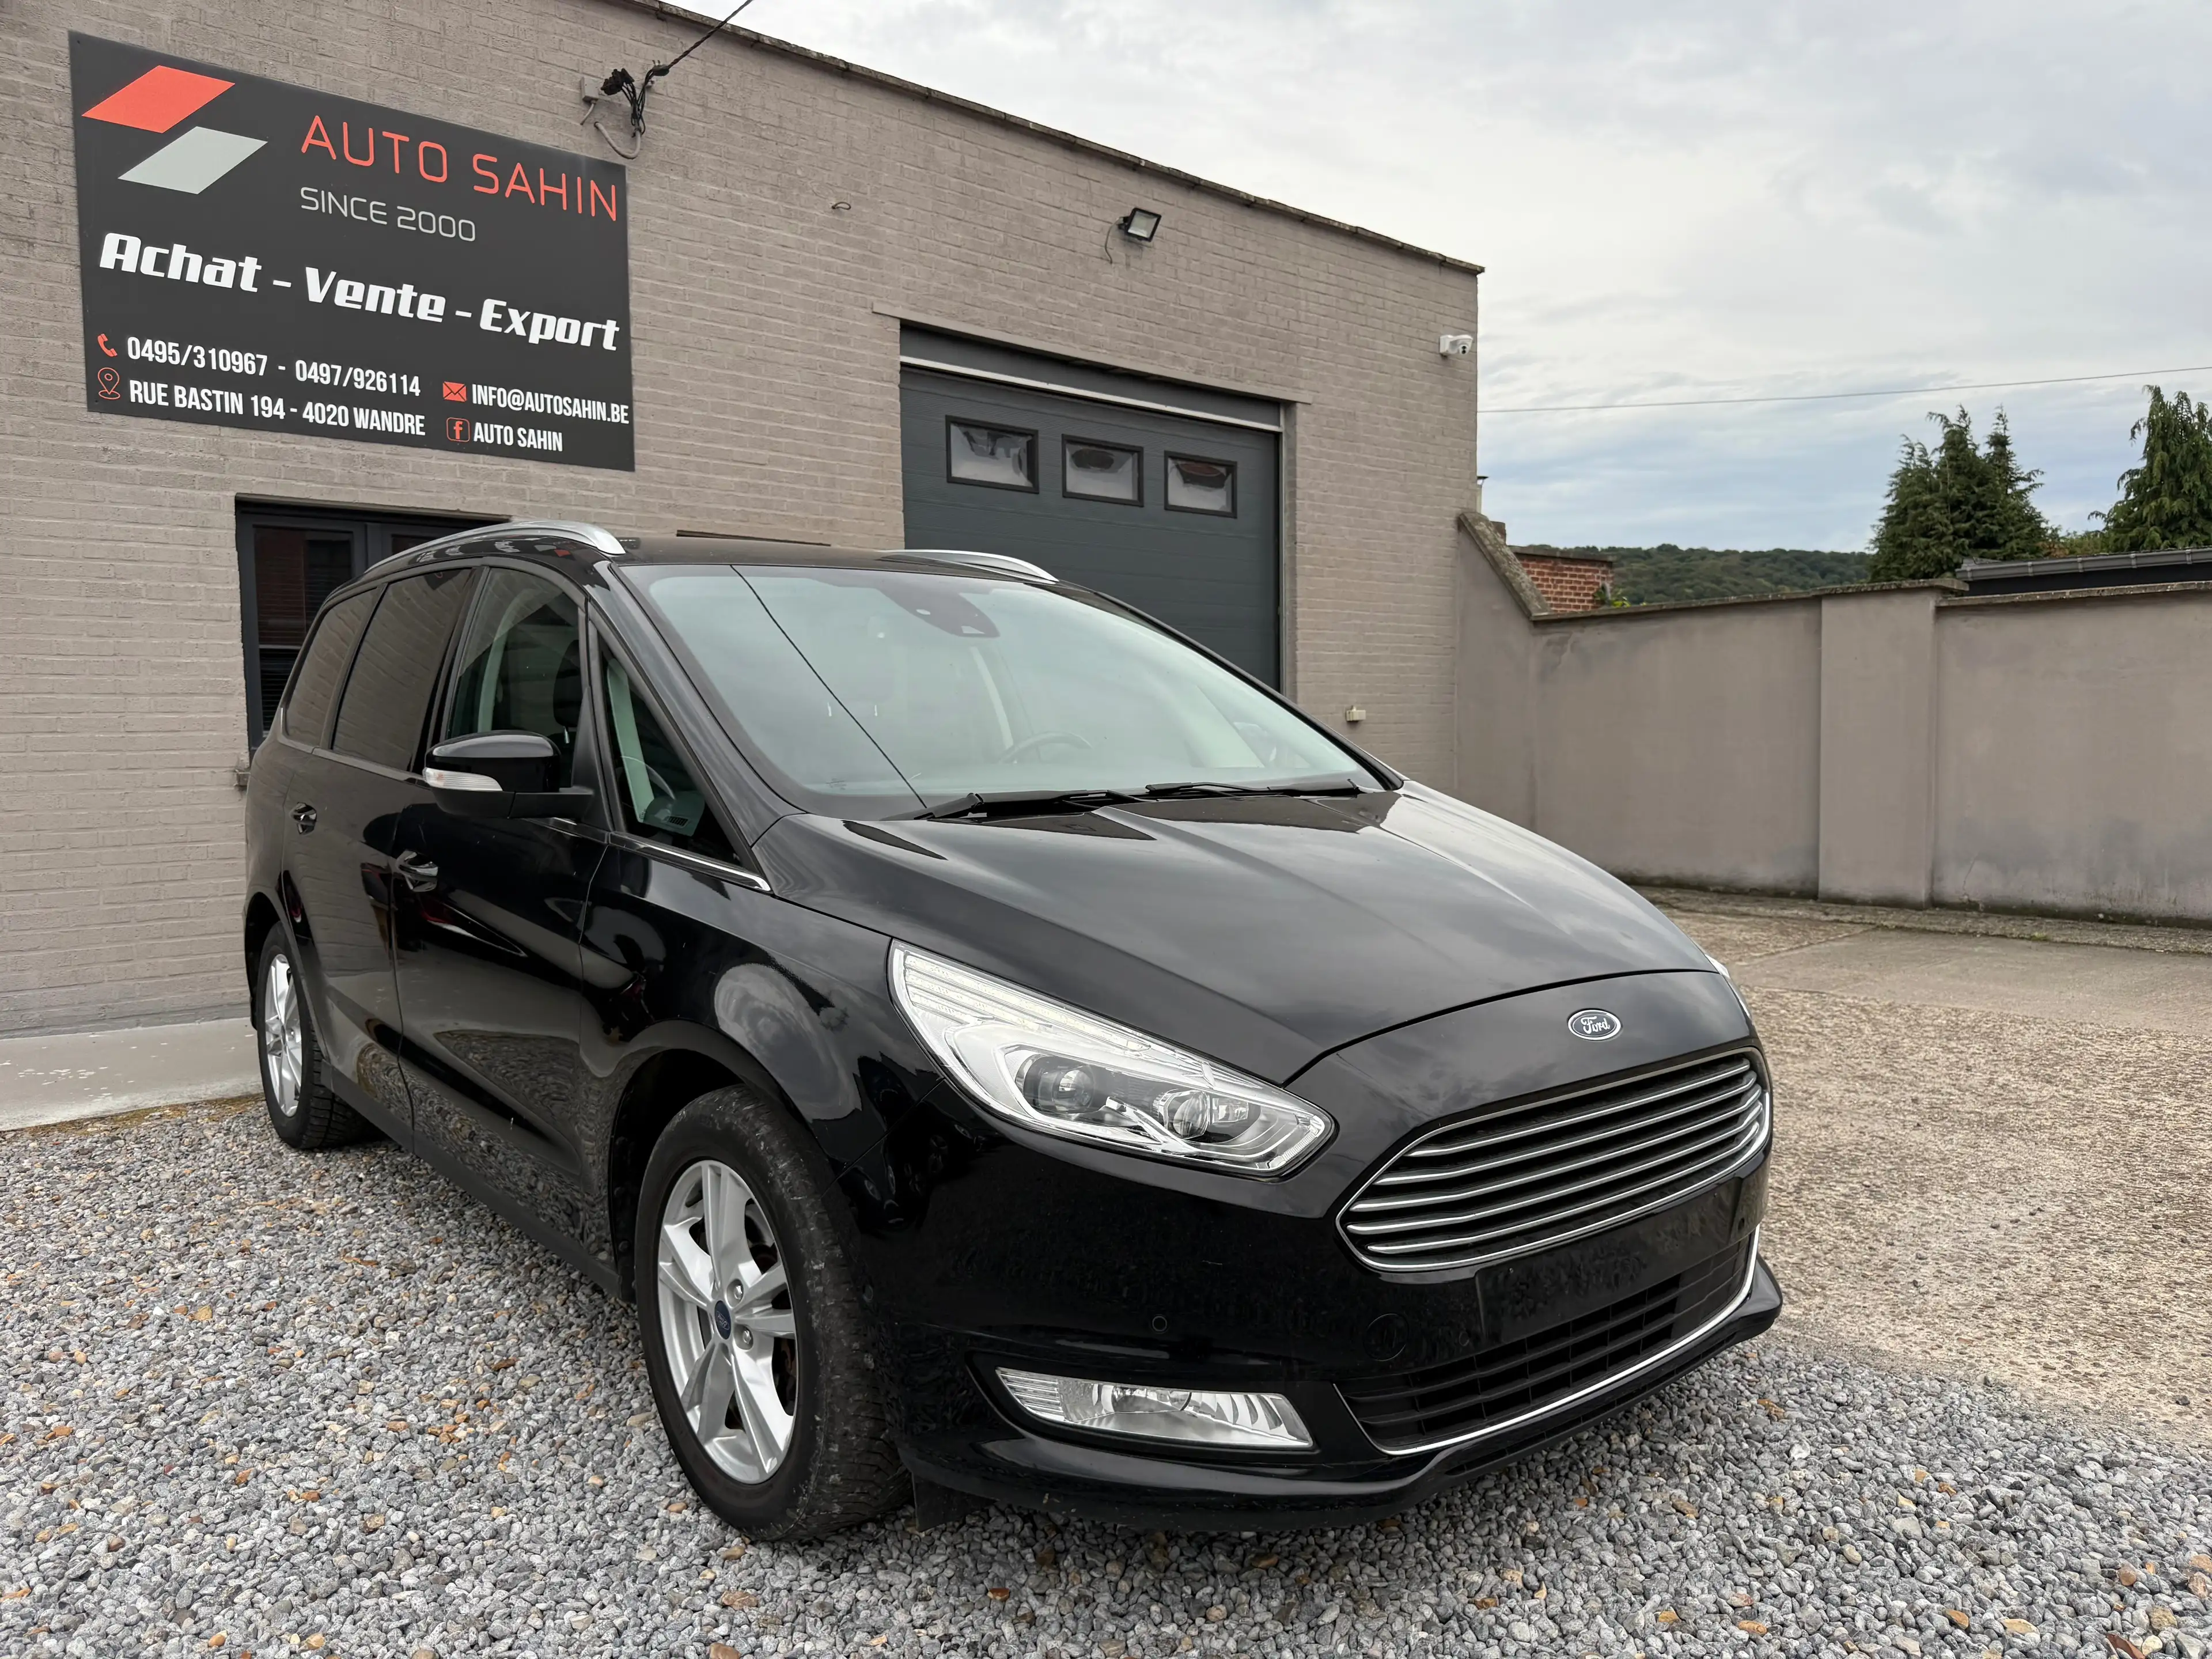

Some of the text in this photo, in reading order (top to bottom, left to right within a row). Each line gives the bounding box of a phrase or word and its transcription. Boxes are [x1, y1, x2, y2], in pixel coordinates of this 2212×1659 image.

[301, 115, 616, 221] AUTO SAHIN
[301, 187, 475, 241] SINCE 2000
[99, 232, 262, 293] Achat
[305, 266, 446, 323] Vente
[479, 298, 620, 351] Export
[127, 336, 268, 376] 0495/310967
[295, 359, 421, 396] 0497/926114
[129, 380, 169, 406] RUE
[174, 385, 244, 415] BASTIN
[250, 395, 286, 420] 194
[302, 401, 349, 427] 4020
[353, 405, 426, 436] WANDRE
[472, 384, 630, 425] INFO@AUTOSAHIN.BE
[474, 422, 514, 446] AUTO
[517, 427, 563, 452] SAHIN
[1581, 1016, 1610, 1034] Ford
